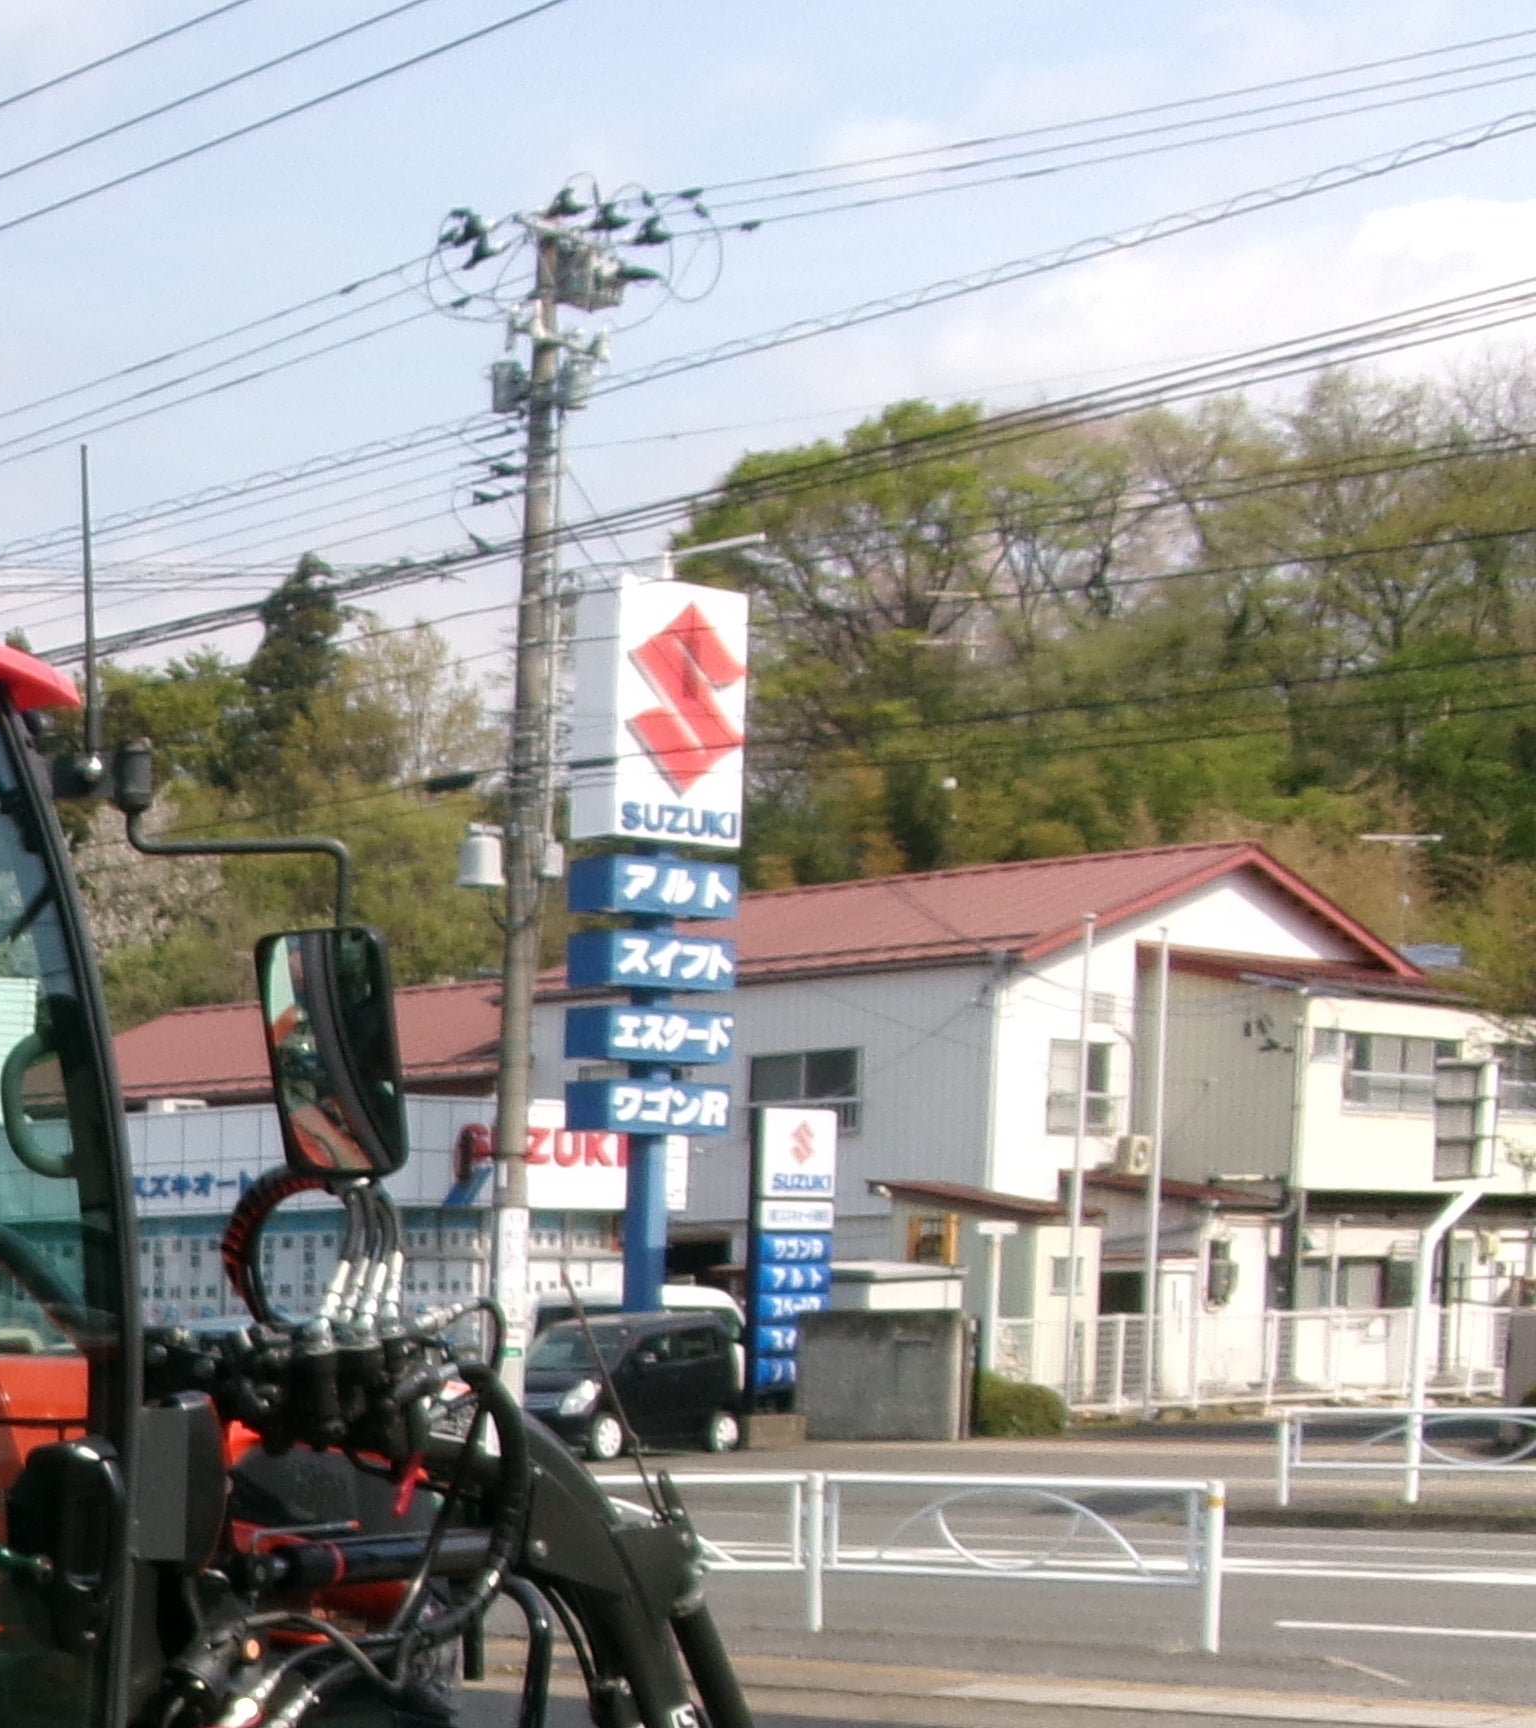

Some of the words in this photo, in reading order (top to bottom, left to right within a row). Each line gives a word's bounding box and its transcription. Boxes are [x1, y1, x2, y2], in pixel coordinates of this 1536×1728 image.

[621, 801, 738, 840] SUZUKI
[623, 864, 732, 908] アルト
[618, 938, 733, 980] スイフト
[614, 1013, 735, 1055] エスクード
[613, 1086, 730, 1127] ワゴンR
[463, 1123, 632, 1168] SZUKI
[772, 1172, 832, 1191] SUZUKI
[772, 1267, 823, 1290] アルト
